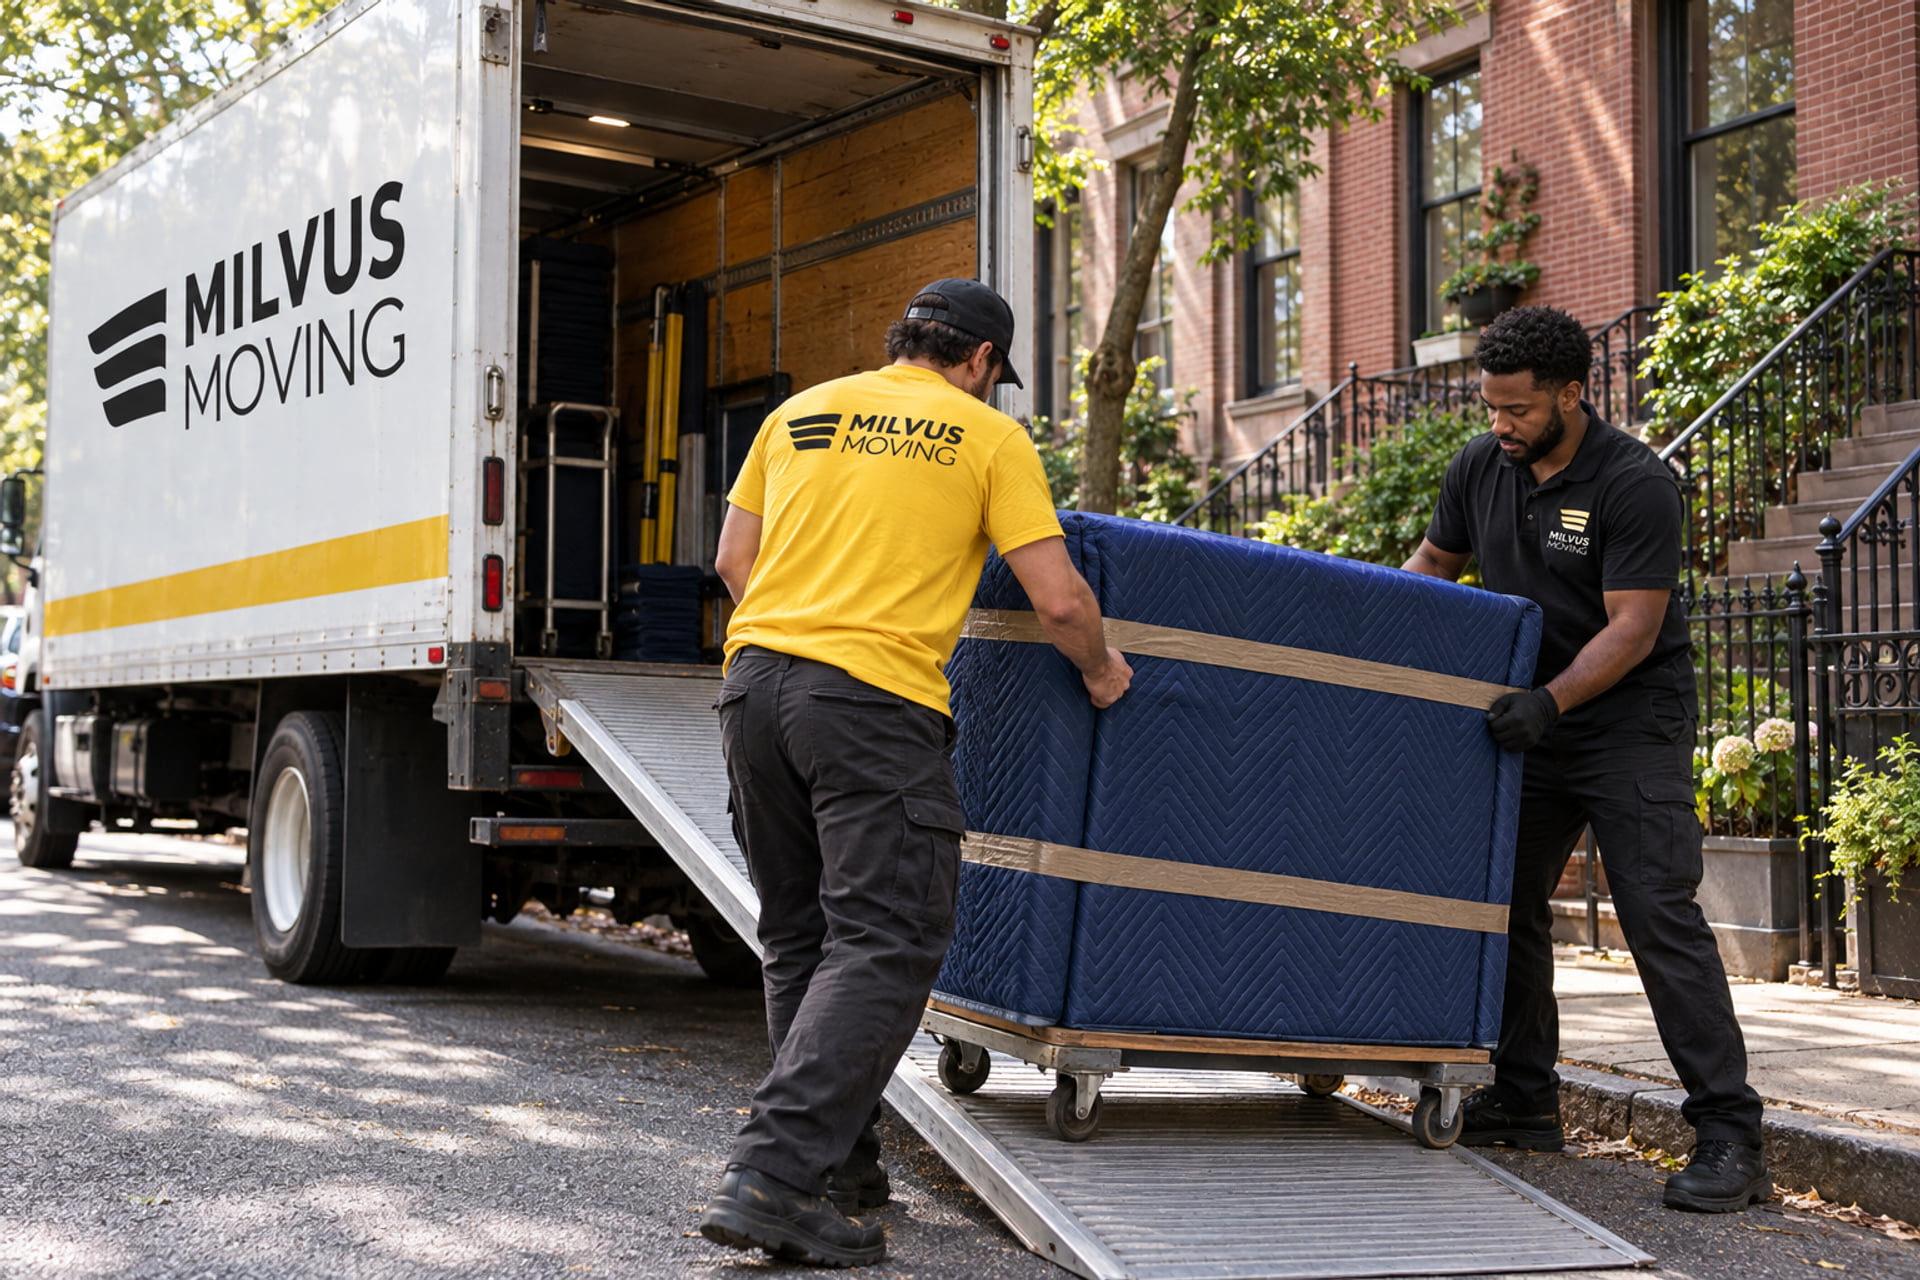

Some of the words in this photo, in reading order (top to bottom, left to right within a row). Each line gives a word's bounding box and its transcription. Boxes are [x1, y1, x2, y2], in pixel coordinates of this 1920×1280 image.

[185, 181, 405, 348] MILVUS
[185, 297, 405, 430] MOVING
[848, 413, 965, 445] MILVUS
[840, 434, 958, 466] MOVING
[1546, 540, 1588, 556] MOVING
[1549, 530, 1590, 546] MILVUS
